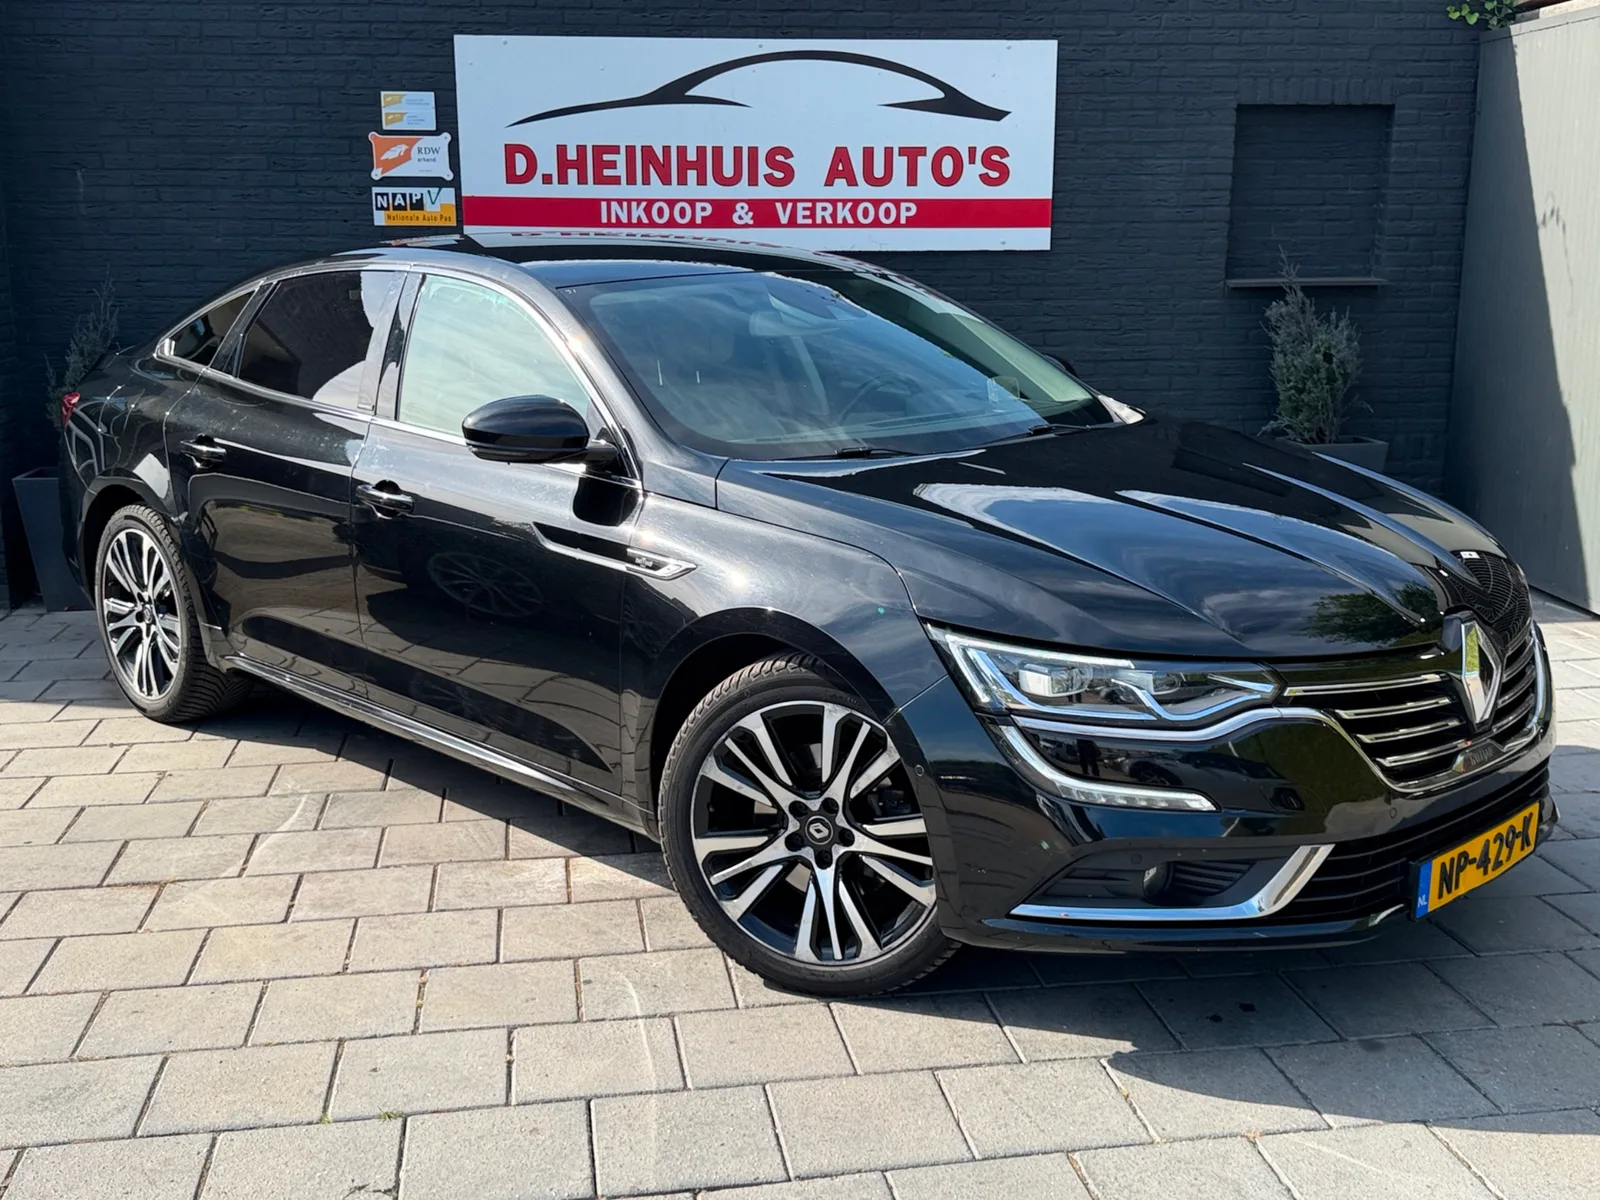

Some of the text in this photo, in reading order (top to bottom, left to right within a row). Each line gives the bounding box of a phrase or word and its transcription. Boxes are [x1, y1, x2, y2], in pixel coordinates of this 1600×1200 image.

[417, 147, 441, 155] RDW
[504, 143, 1011, 187] D.HEINHUIS AUTO'S
[386, 213, 452, 222] Nationale Auto Pas
[600, 201, 917, 225] INKOOP & VERKOOP
[1437, 811, 1534, 900] NP-429-K
[1417, 894, 1428, 908] NL
